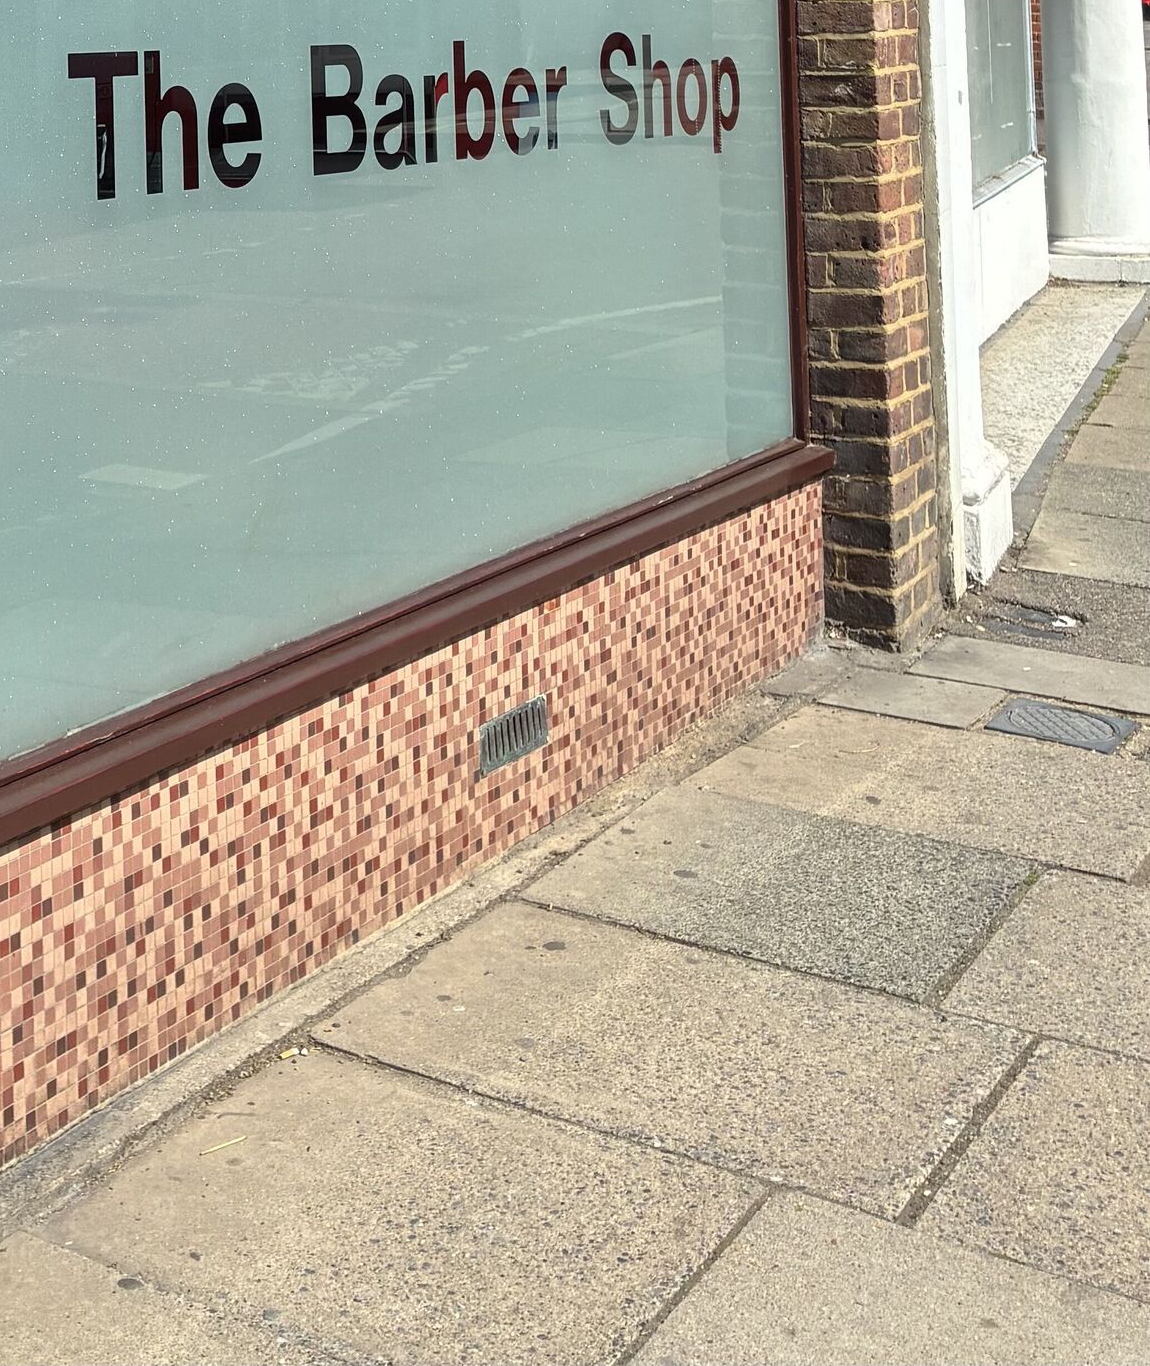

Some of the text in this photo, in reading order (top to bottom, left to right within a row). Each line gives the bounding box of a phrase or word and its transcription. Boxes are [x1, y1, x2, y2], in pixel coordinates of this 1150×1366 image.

[67, 31, 740, 201] The Barber Shop
